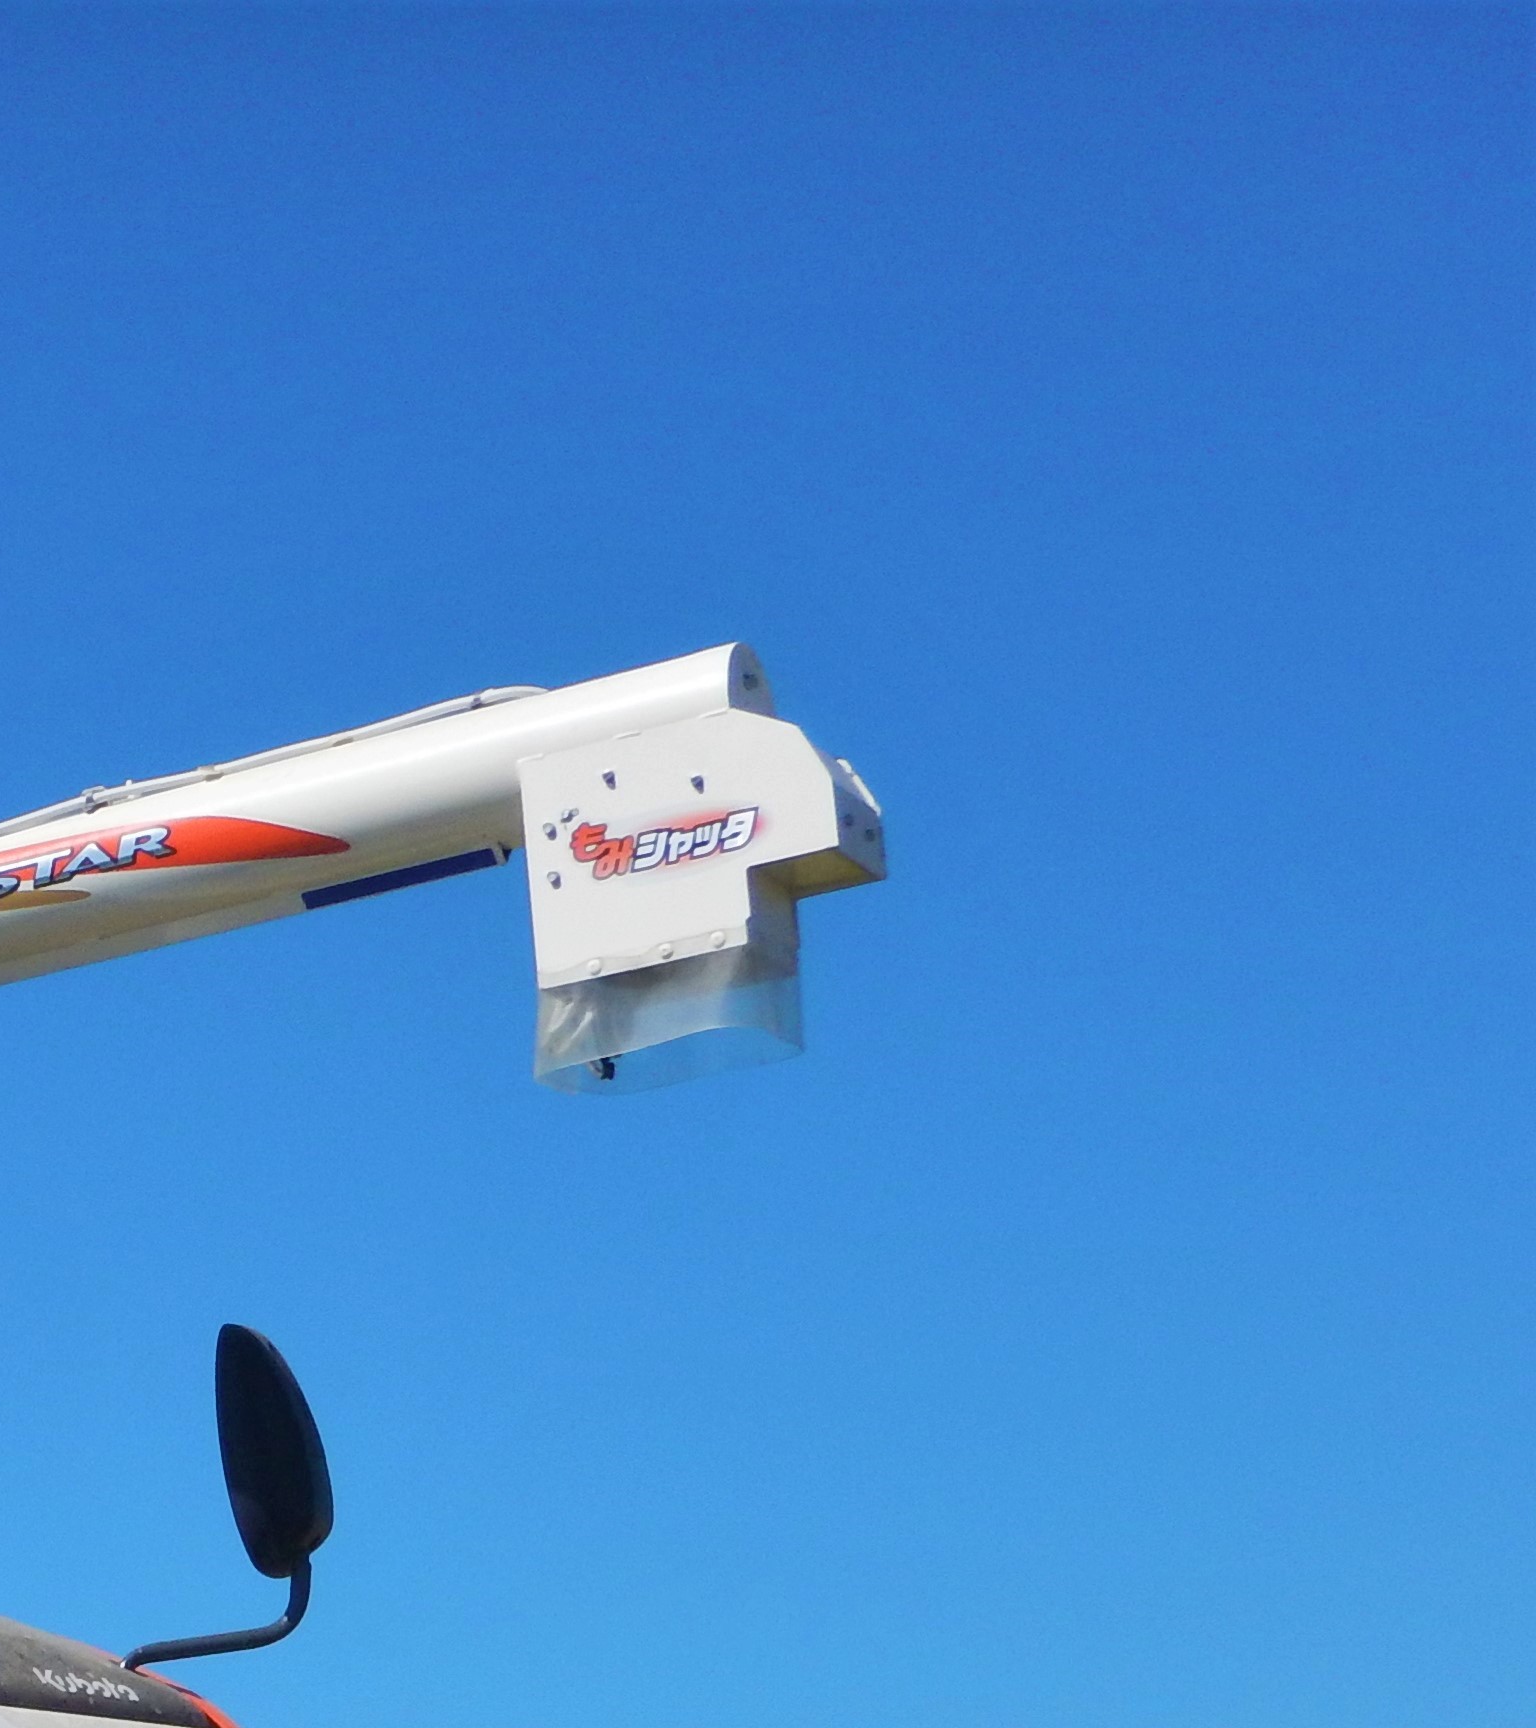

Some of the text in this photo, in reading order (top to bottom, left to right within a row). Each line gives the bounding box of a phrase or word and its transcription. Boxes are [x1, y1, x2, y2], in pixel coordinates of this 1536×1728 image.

[570, 807, 758, 879] もみシャッタ
[33, 1667, 139, 1701] Kubota
